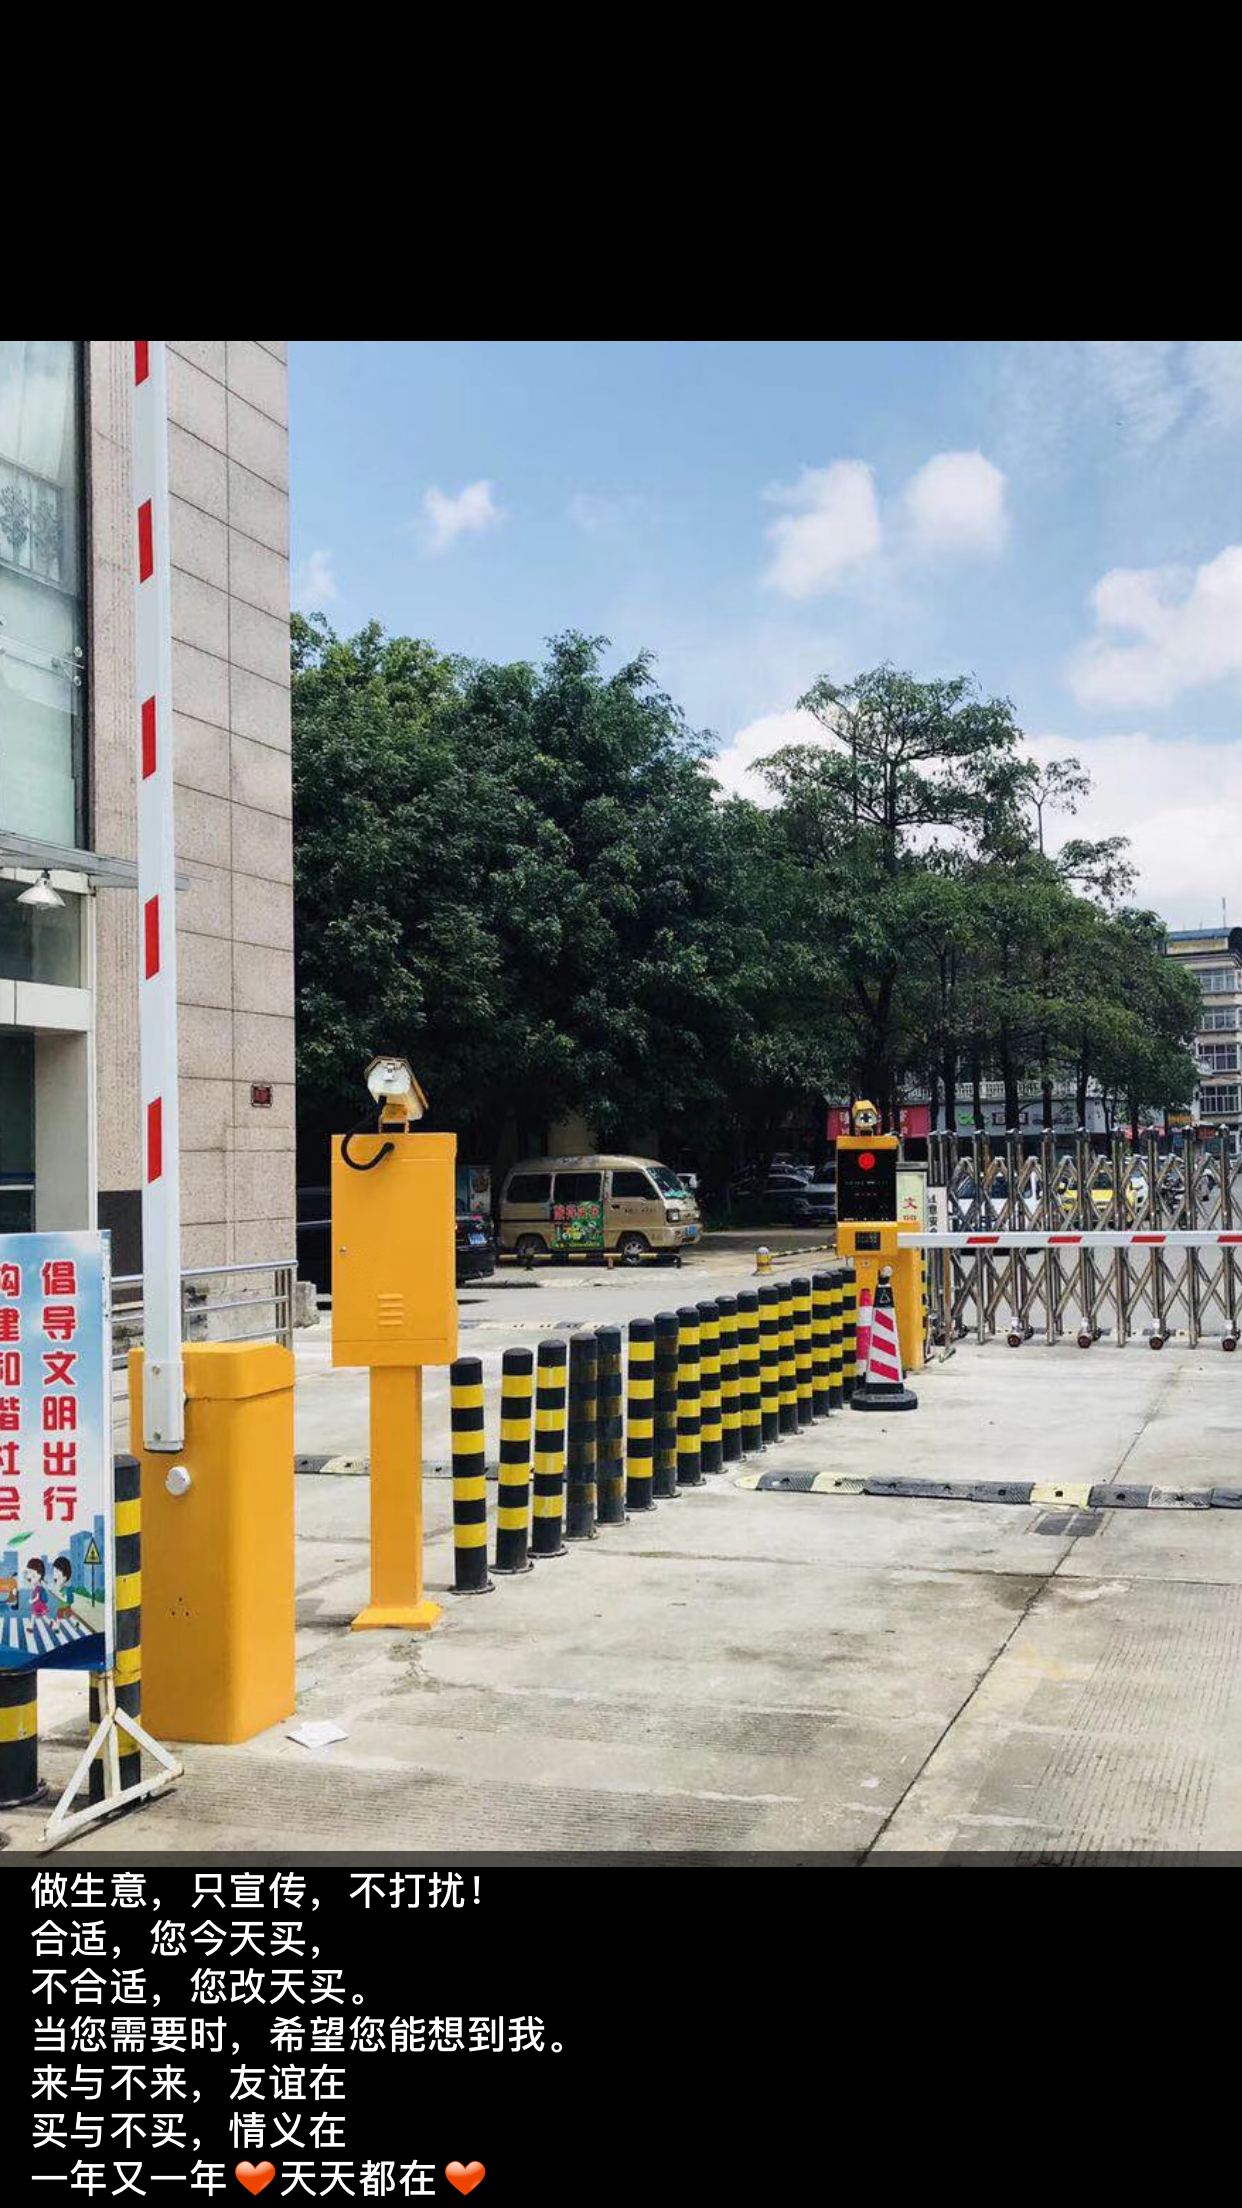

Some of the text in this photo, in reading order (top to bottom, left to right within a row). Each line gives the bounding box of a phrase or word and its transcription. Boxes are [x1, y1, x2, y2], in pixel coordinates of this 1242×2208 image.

[41, 1261, 77, 1522] 倡导文明出行
